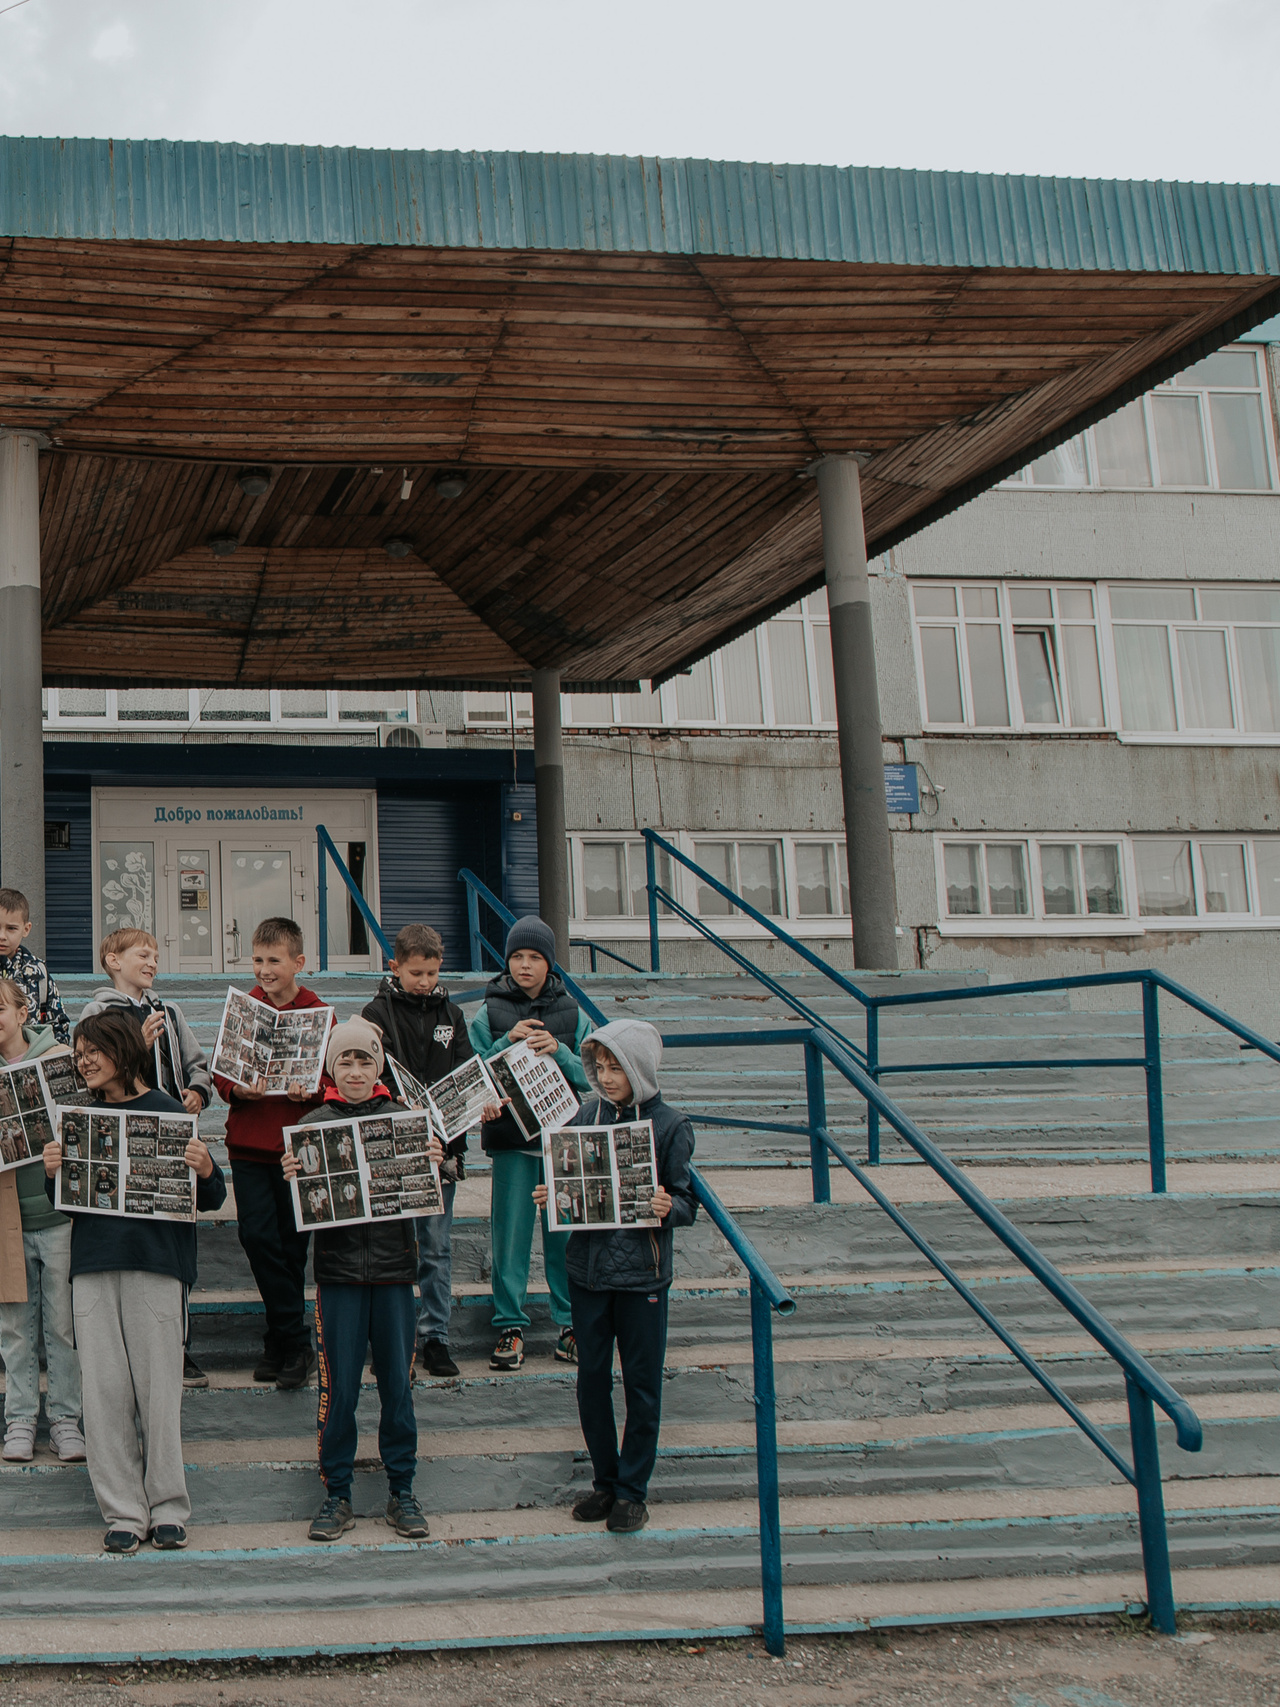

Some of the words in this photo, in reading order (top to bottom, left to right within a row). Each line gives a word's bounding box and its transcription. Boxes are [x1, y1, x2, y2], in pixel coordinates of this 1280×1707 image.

[154, 806, 202, 824] Добро
[206, 805, 304, 821] пожаловать!
[318, 1351, 329, 1388] MESSI
[318, 1392, 329, 1423] NETO
